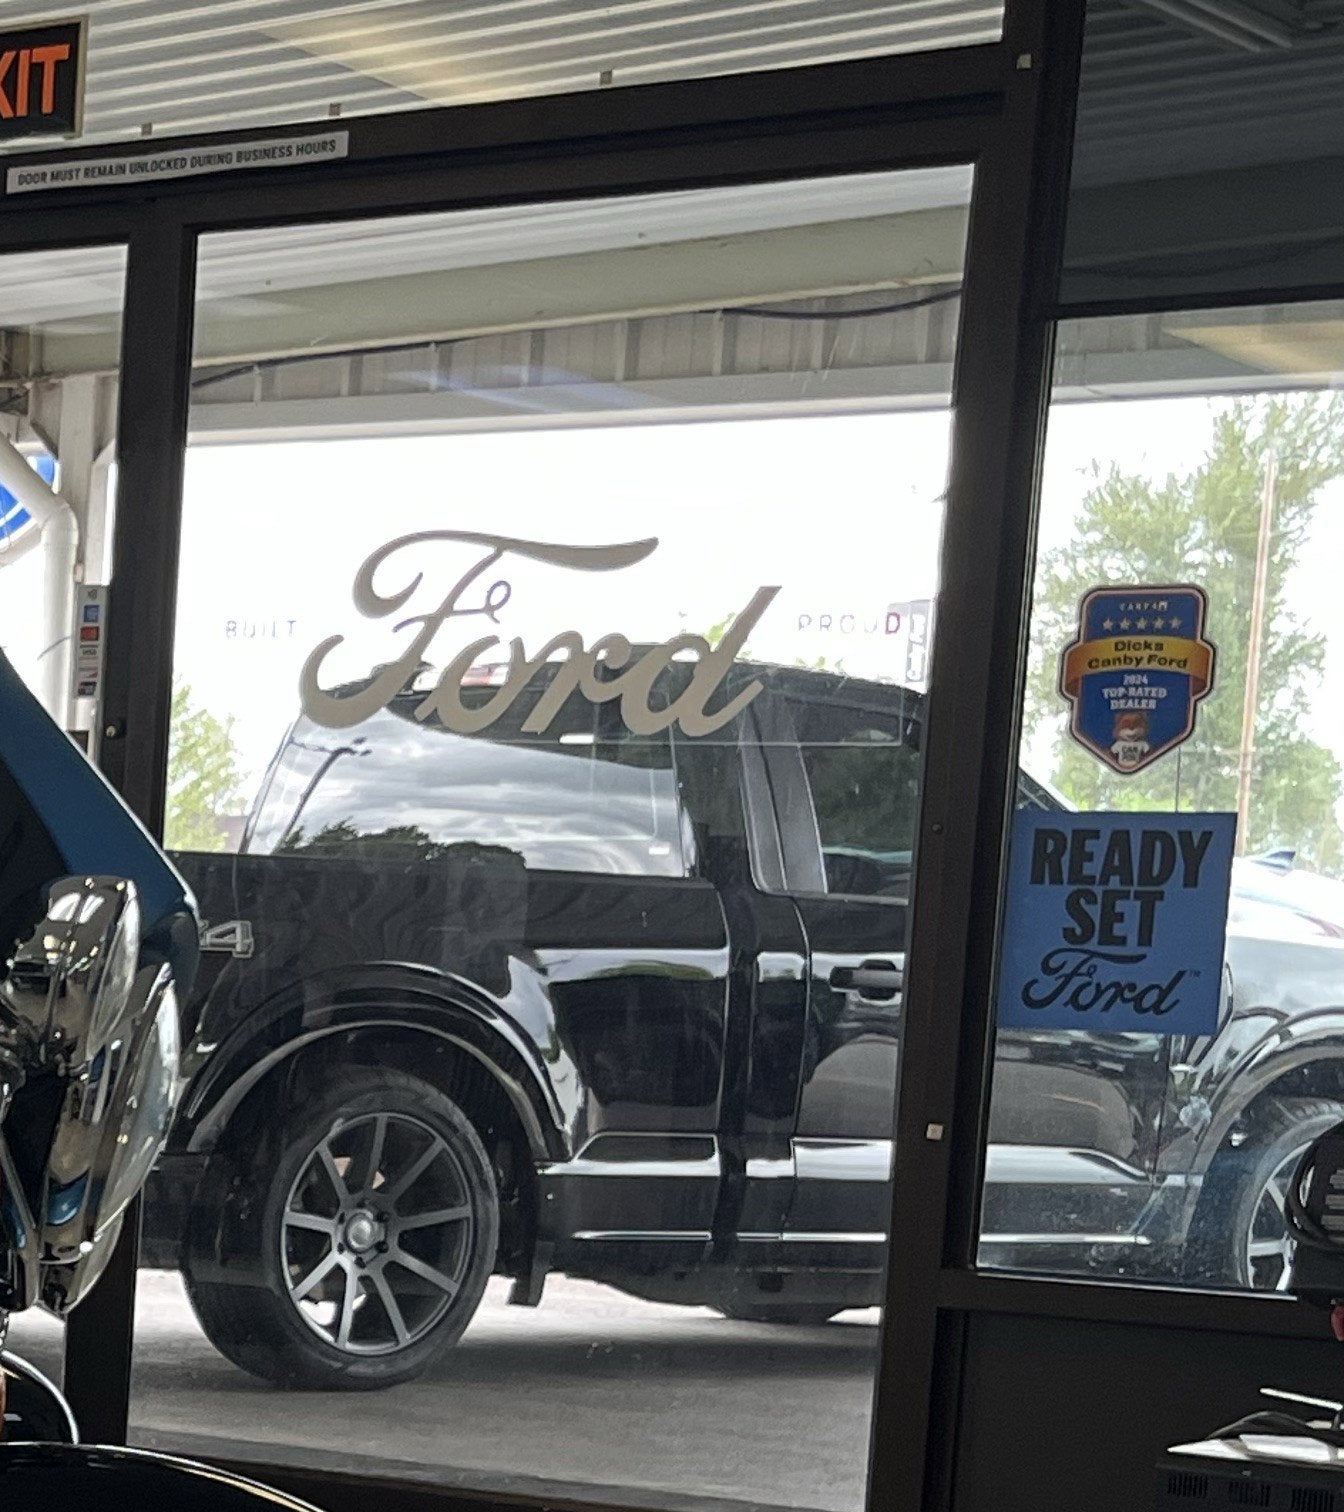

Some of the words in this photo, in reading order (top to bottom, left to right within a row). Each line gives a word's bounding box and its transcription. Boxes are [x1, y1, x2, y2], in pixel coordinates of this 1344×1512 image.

[18, 171, 47, 186] DOOR
[50, 167, 81, 182] MUST
[83, 162, 127, 179] REMAIN
[129, 156, 187, 175] UNLOCKED
[190, 151, 233, 169] DURING
[236, 144, 293, 164] BUSINESS
[296, 139, 337, 157] HOURS
[299, 529, 782, 738] Ford
[1087, 654, 1144, 670] Canby
[1146, 653, 1189, 669] Ford
[1114, 640, 1164, 652] Dicks
[1029, 828, 1213, 889] READY
[1062, 888, 1165, 947] SET
[1021, 947, 1188, 1016] Ford
